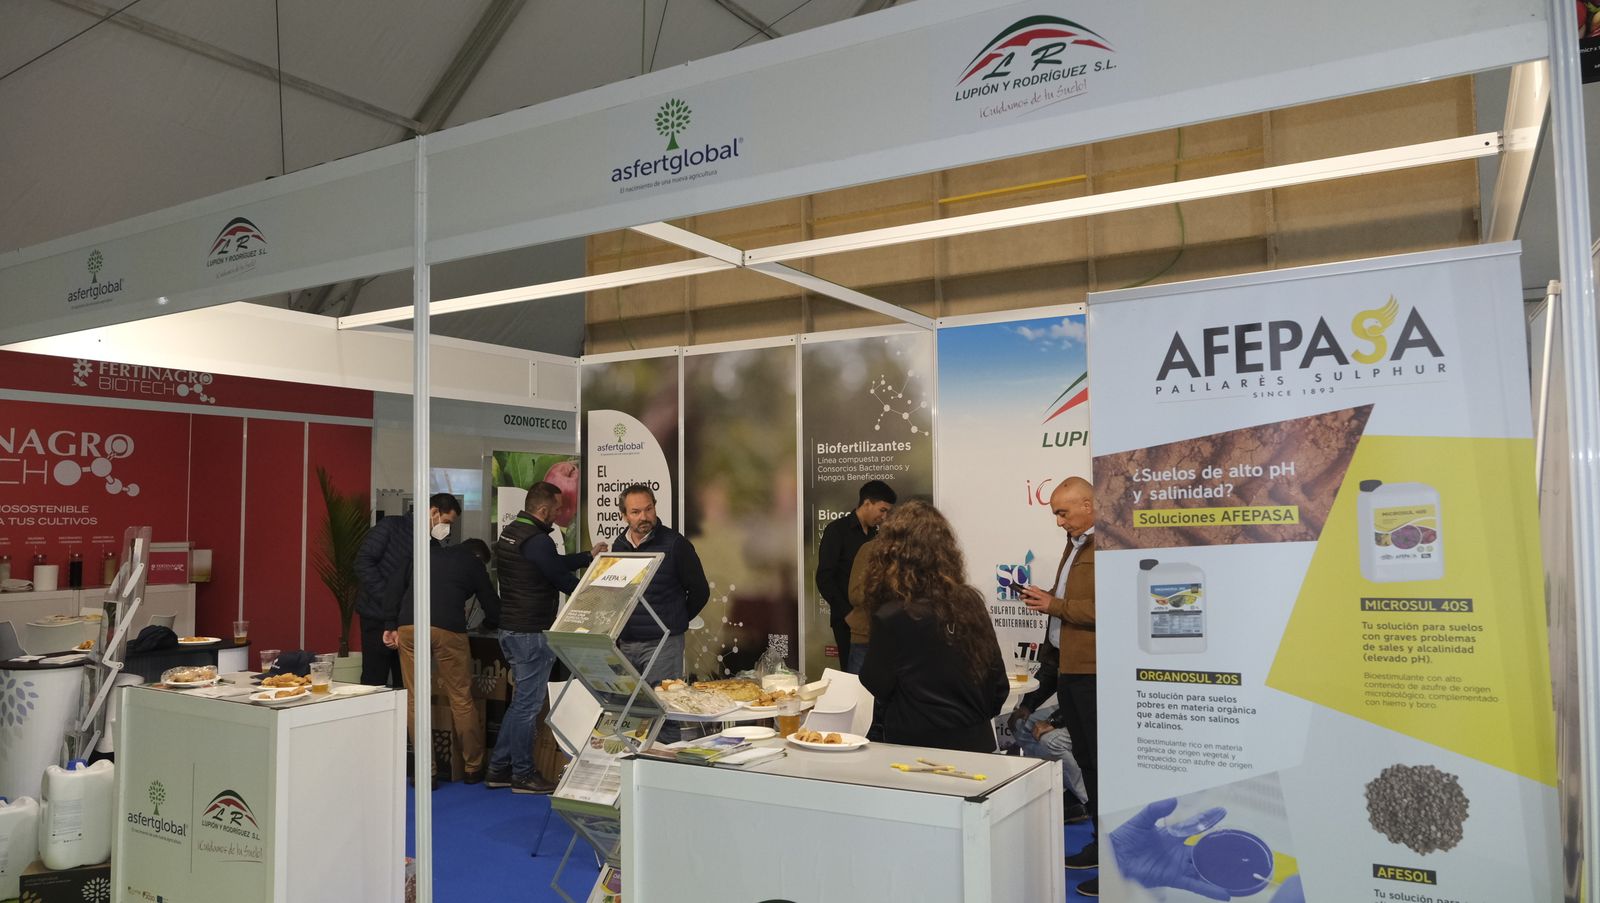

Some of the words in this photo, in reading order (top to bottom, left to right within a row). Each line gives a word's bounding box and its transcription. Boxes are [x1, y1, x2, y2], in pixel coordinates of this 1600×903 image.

[1031, 42, 1067, 71] R
[955, 82, 999, 101] LUPIÓN
[1002, 80, 1010, 91] Y
[1012, 64, 1088, 90] RODRÍGUEZ
[1093, 59, 1117, 72] S.L.
[1156, 294, 1445, 381] AFEPASA
[100, 361, 213, 385] FERTINAGRO
[1155, 373, 1285, 395] PALLARÈS
[1315, 363, 1447, 383] SULPHUR
[1252, 389, 1292, 399] SINCE
[1302, 386, 1335, 396] 1893
[503, 414, 550, 430] OZONOTEC
[551, 420, 568, 431] ECO
[817, 440, 912, 454] Biofertilizantes
[817, 456, 837, 464] Línea
[838, 456, 879, 465] compuesta
[880, 456, 894, 464] por
[597, 465, 607, 478] El
[817, 465, 857, 473] Consorcios
[859, 463, 903, 472] Bacterianos
[904, 464, 910, 472] y
[1132, 467, 1196, 483] ¿Suelos
[1201, 465, 1223, 479] de
[1229, 463, 1264, 478] alto
[1269, 461, 1295, 480] pH
[817, 474, 846, 483] Hongos
[847, 472, 896, 481] Beneficiosos.
[1132, 489, 1142, 504] y
[1150, 483, 1234, 501] salinidad?
[597, 495, 611, 507] de
[8, 517, 35, 526] TUS
[38, 517, 98, 526] CULTIVOS
[1139, 510, 1216, 525] Soluciones
[1221, 508, 1294, 523] AFEPASA
[990, 606, 1016, 615] SULFATO
[1365, 600, 1437, 611] MICROSUL
[1441, 601, 1469, 612] 40S
[994, 618, 1038, 628] MEDITERRANEO
[1362, 621, 1373, 630] Tu
[1376, 622, 1419, 631] solución
[1422, 624, 1446, 633] para
[1449, 623, 1483, 632] suelos
[1362, 633, 1381, 641] con
[1384, 634, 1417, 643] graves
[1420, 634, 1476, 643] problemas
[1362, 643, 1376, 651] de
[1379, 643, 1404, 652] sales
[1416, 645, 1475, 654] alcalinidad
[1362, 653, 1408, 663] (elevado
[1411, 655, 1433, 664] pH).
[1139, 670, 1212, 684] ORGANOSUL
[1215, 673, 1239, 685] 20S
[1364, 672, 1425, 681] Bioestimulante
[1445, 675, 1462, 683] alto
[1364, 682, 1406, 690] contenido
[1407, 683, 1419, 691] de
[1421, 684, 1447, 692] azufre
[1463, 686, 1491, 694] origen
[1136, 690, 1147, 699] Tu
[1148, 691, 1184, 701] solución
[1186, 694, 1206, 703] para
[1208, 695, 1237, 704] suelos
[1428, 693, 1500, 703] complementado
[1136, 701, 1165, 710] pobres
[1181, 704, 1215, 713] materia
[1217, 705, 1257, 716] orgánica
[1382, 699, 1407, 708] hierro
[604, 719, 632, 728] AFEOL
[1136, 712, 1153, 720] que
[1155, 712, 1188, 721] además
[1190, 714, 1206, 722] son
[1208, 715, 1240, 724] salinos
[1136, 721, 1142, 729] y
[1144, 720, 1183, 731] alcalinos.
[1136, 737, 1188, 748] Bioestimulante
[1188, 741, 1203, 749] rico
[1215, 743, 1243, 752] materia
[1136, 746, 1166, 755] orgánica
[1178, 749, 1200, 758] origen
[1202, 752, 1229, 761] vegetal
[1136, 755, 1177, 764] enriquecido
[1193, 758, 1216, 767] azufre
[1217, 760, 1227, 768] de
[1229, 761, 1253, 770] origen
[1136, 762, 1188, 773] microbiológico.
[1377, 866, 1432, 883] AFESOL
[1374, 889, 1386, 898] Tu
[1389, 890, 1433, 903] solución
